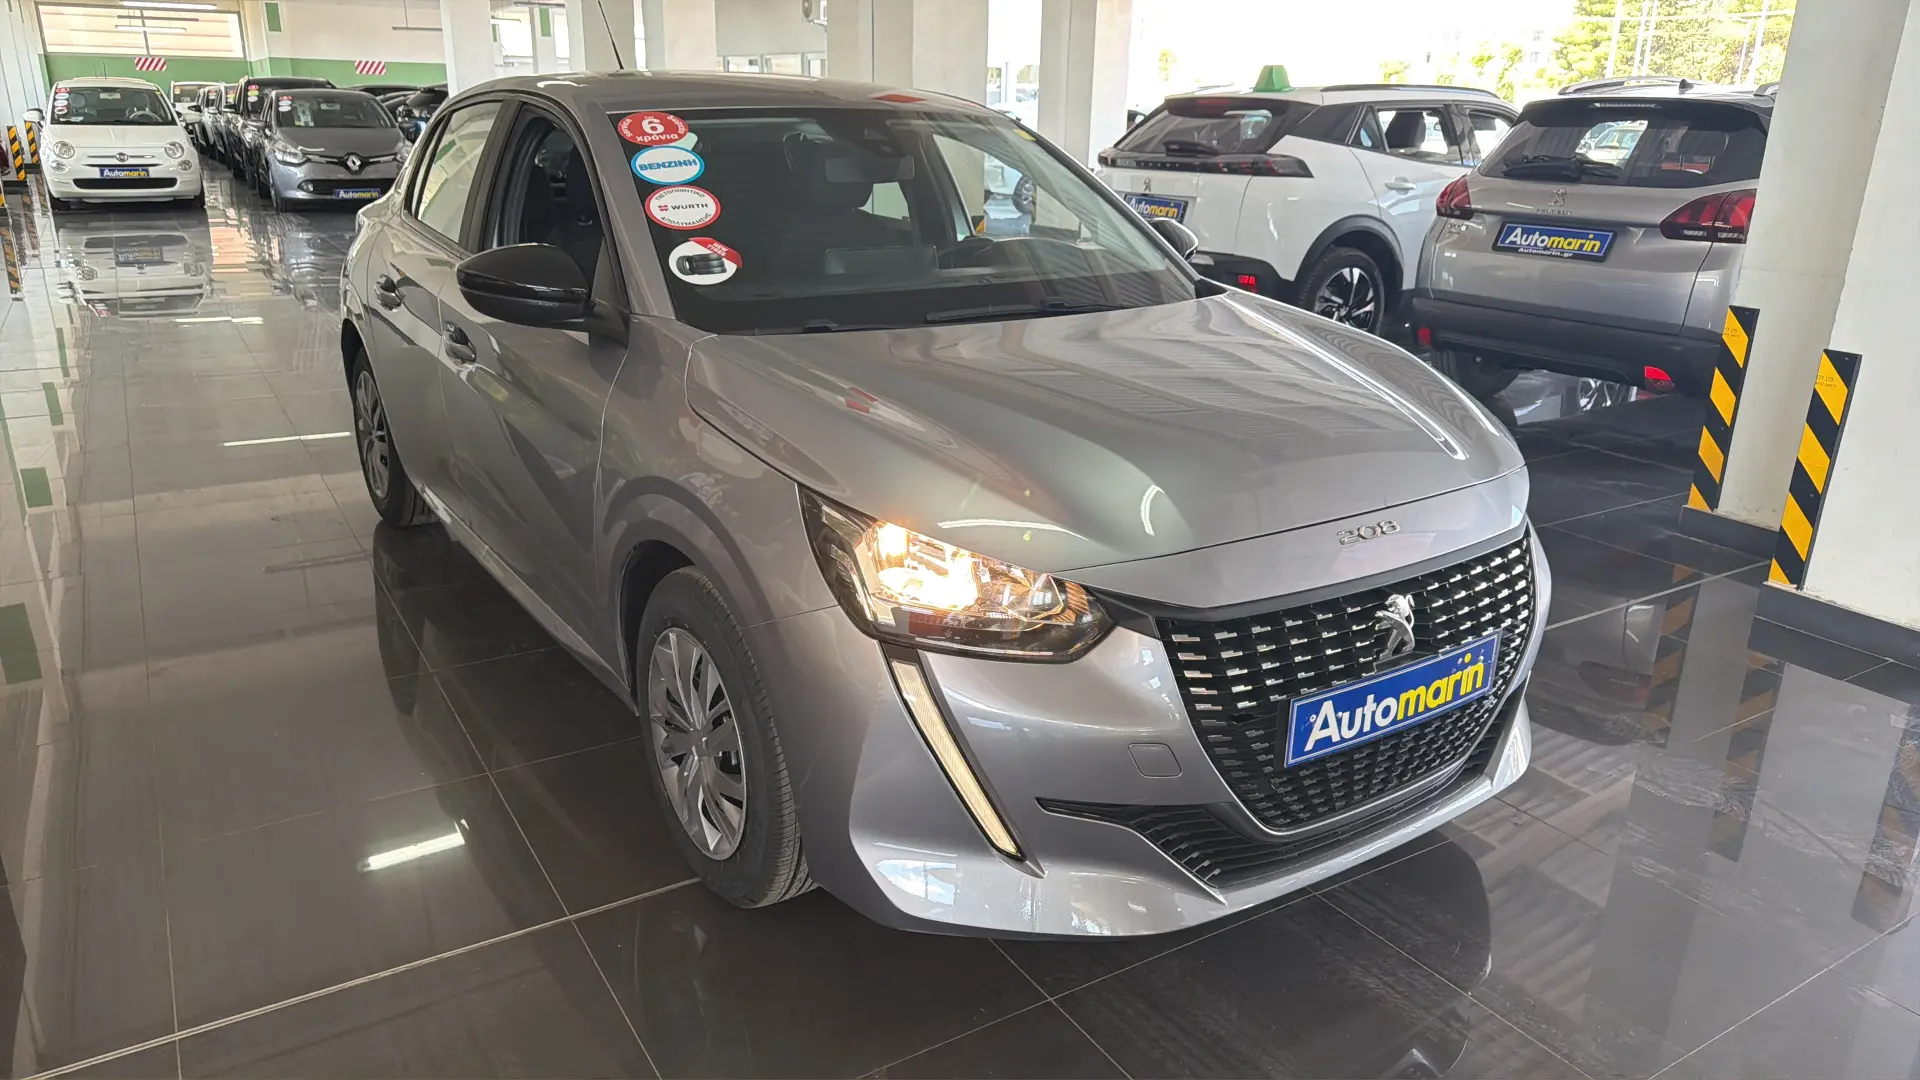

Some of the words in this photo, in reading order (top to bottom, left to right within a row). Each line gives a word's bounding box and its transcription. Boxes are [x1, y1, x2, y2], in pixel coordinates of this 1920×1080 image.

[641, 118, 665, 135] 6
[635, 133, 679, 143] χρόνια
[103, 168, 148, 177] Automarin
[339, 189, 379, 199] Automarin
[1129, 197, 1178, 218] Automarin
[1505, 227, 1601, 253] Automarin
[1517, 246, 1574, 258] Automarin.gr
[1337, 519, 1400, 546] 208
[1304, 652, 1484, 751] Automarin
